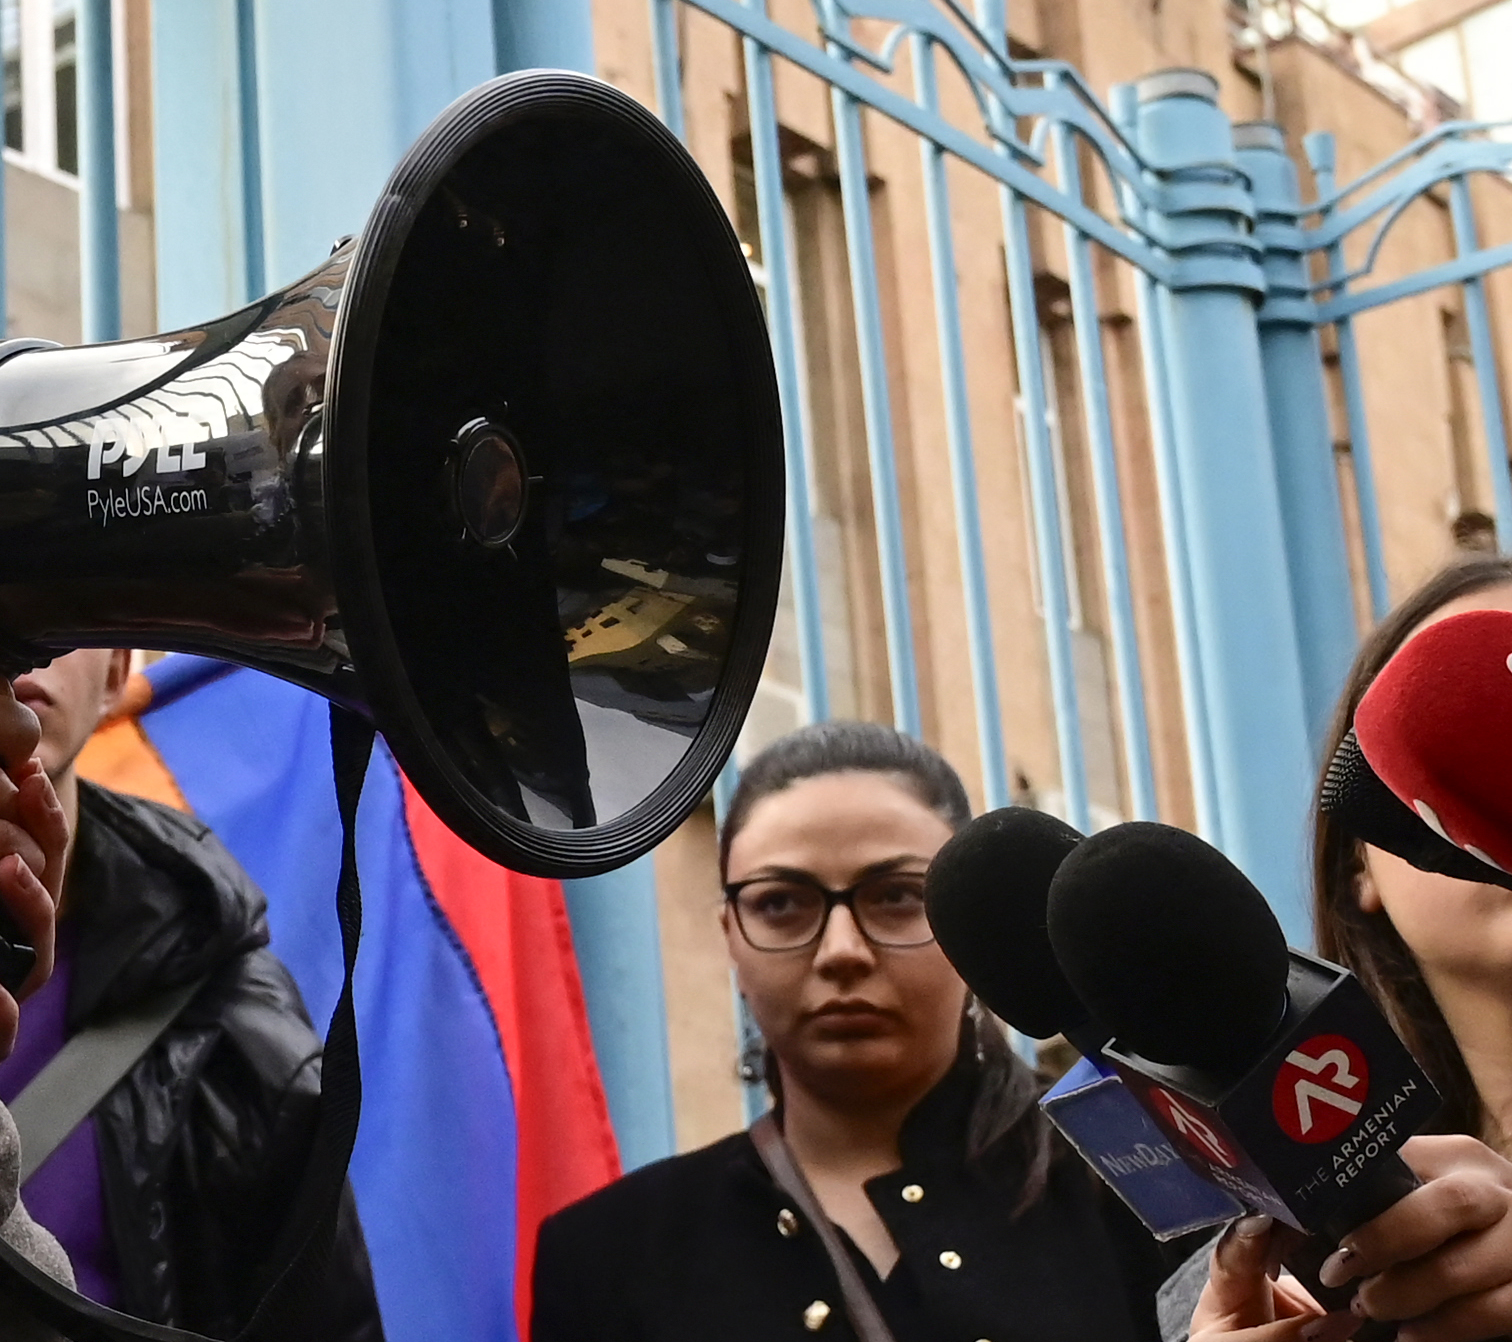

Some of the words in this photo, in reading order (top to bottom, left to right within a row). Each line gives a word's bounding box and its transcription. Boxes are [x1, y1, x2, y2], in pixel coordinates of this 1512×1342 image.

[86, 486, 208, 526] PyleUSA.com
[1295, 1166, 1331, 1201] THE
[1330, 1077, 1418, 1171] ARMENIAN
[1335, 1121, 1399, 1189] REPORT
